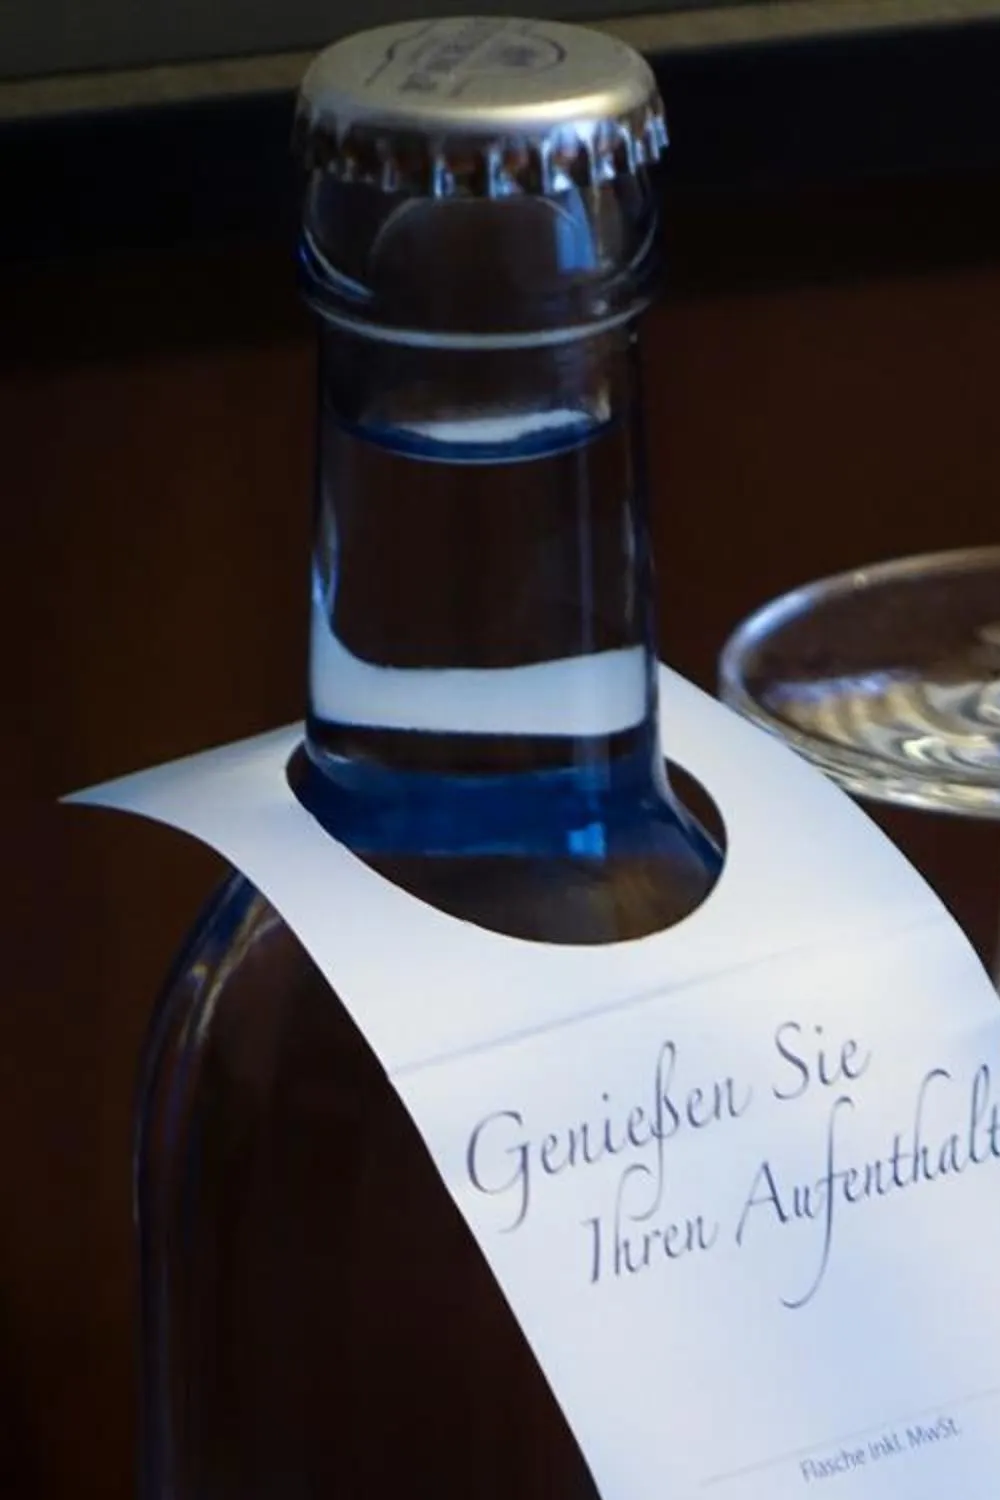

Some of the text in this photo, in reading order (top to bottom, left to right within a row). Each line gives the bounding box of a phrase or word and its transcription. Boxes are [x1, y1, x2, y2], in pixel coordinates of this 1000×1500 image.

[466, 1021, 870, 1233] Genießen Sie
[582, 1163, 717, 1282] Ihren
[800, 1449, 866, 1482] Flasche
